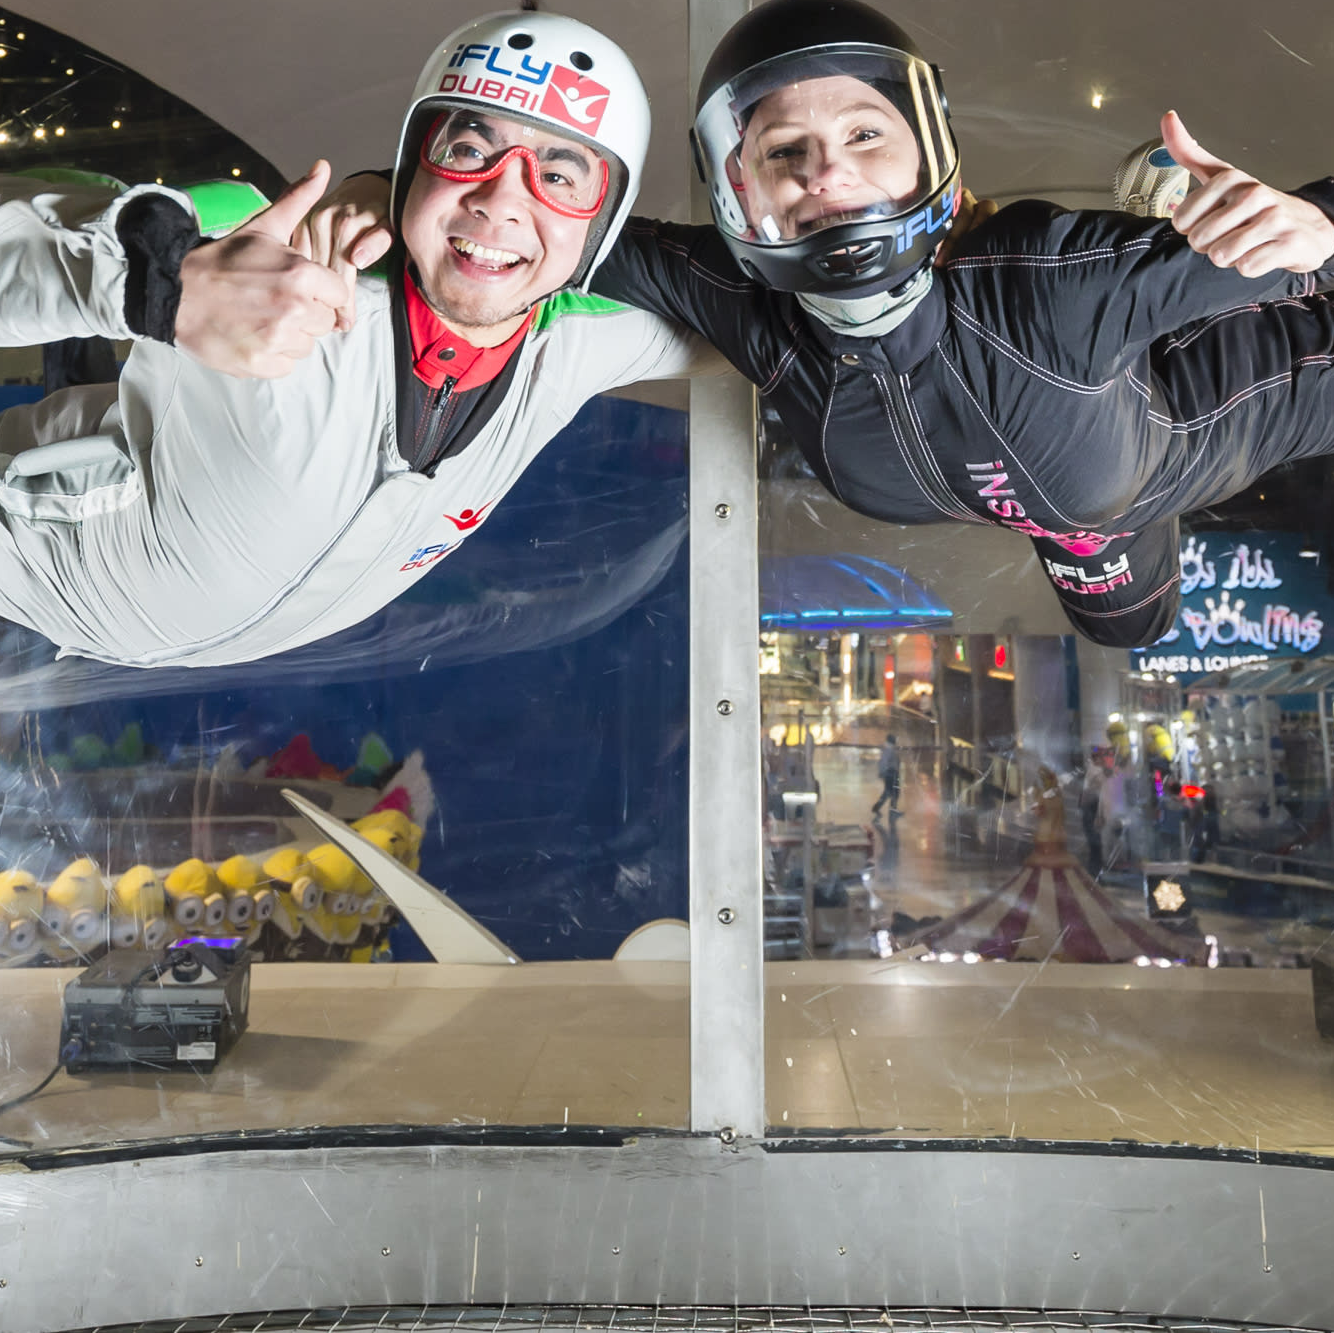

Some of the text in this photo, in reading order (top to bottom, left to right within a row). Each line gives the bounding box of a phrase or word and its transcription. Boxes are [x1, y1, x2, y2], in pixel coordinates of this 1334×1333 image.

[448, 44, 552, 85] iFLY
[438, 74, 540, 112] DUBAI
[895, 182, 954, 255] iFLY
[1044, 553, 1129, 584] iFLY
[1053, 570, 1133, 595] DUBAI
[1139, 655, 1188, 673] LANES
[1190, 655, 1203, 672] &
